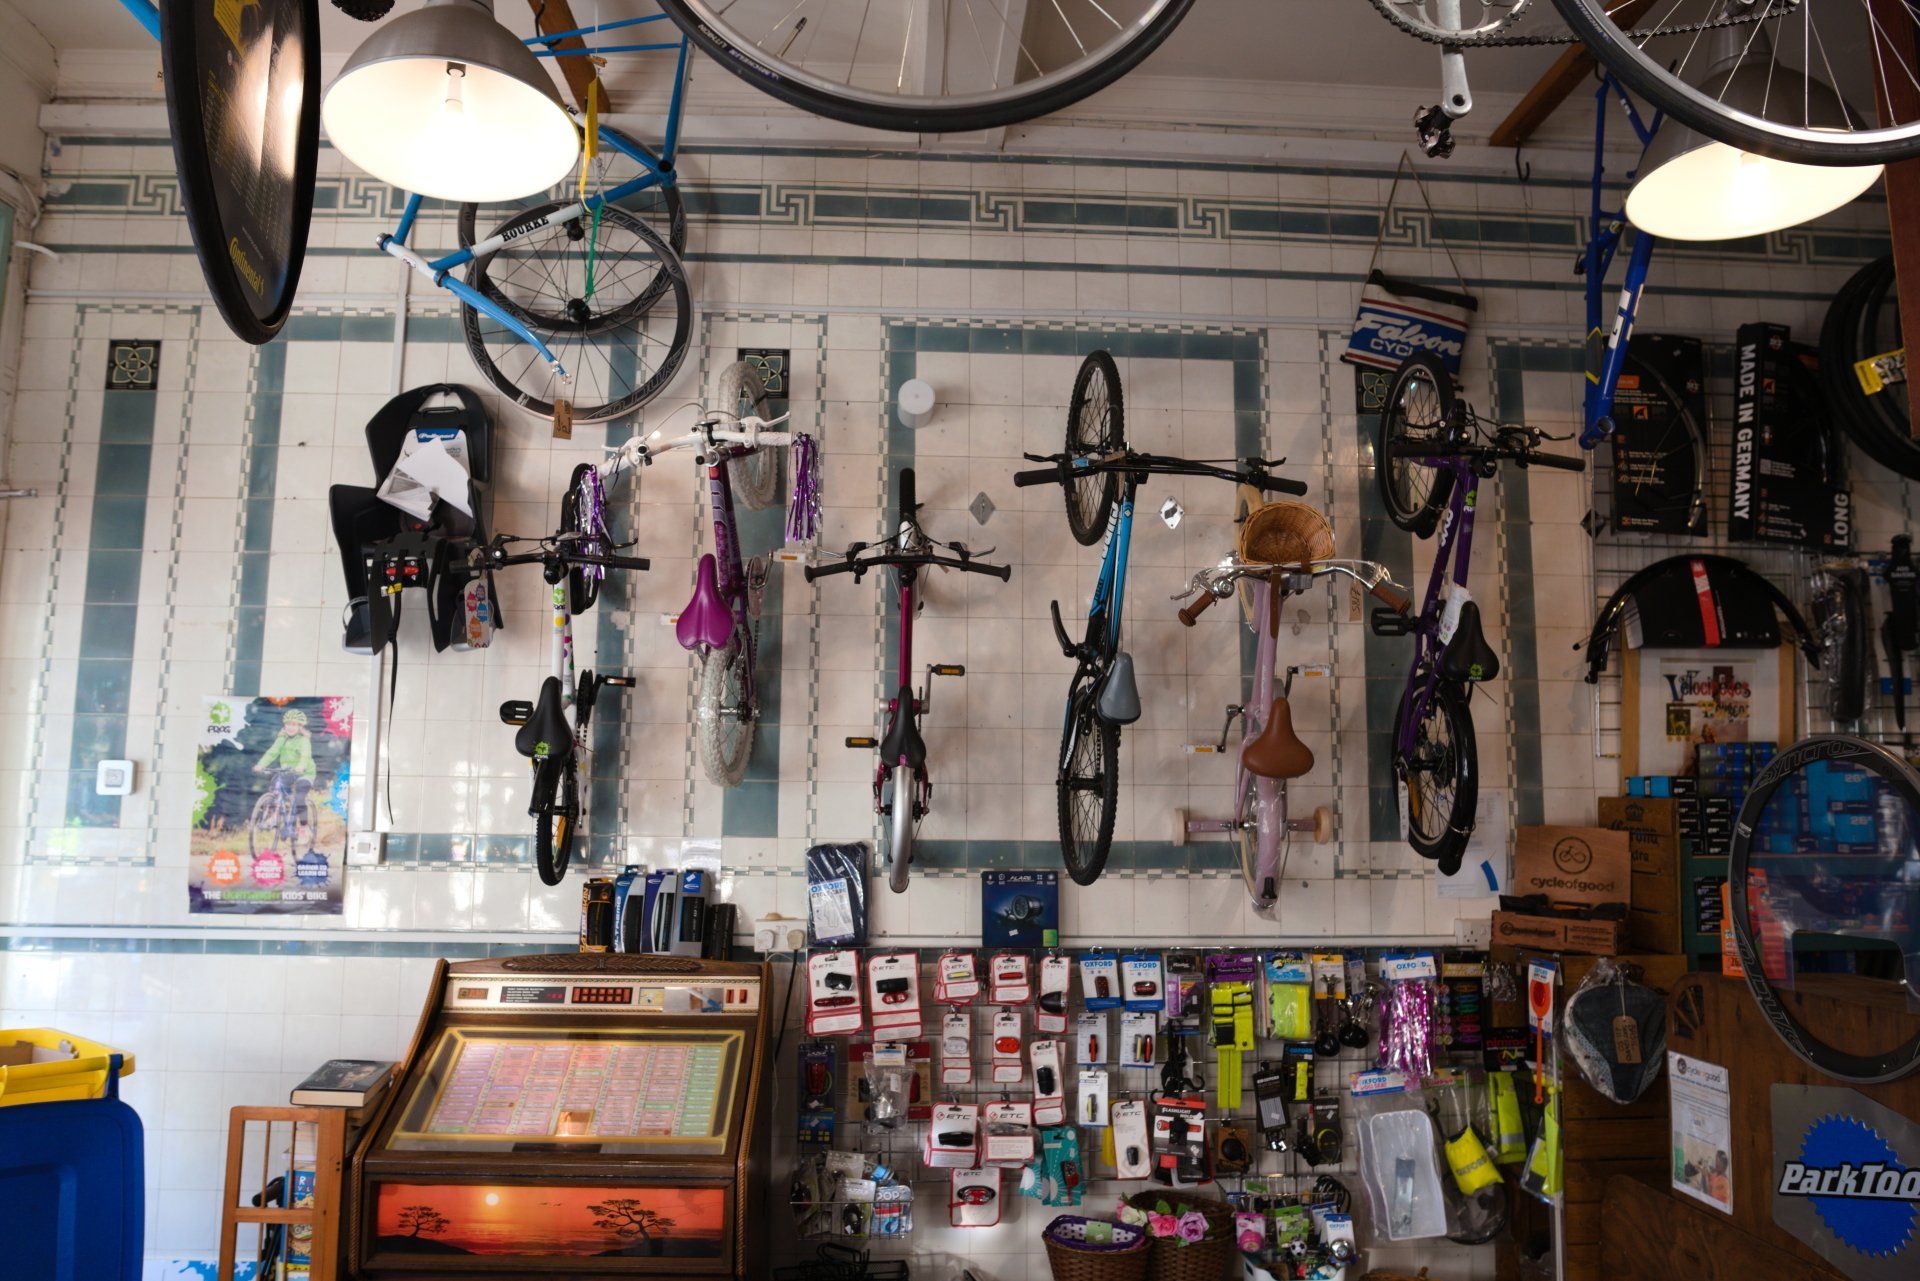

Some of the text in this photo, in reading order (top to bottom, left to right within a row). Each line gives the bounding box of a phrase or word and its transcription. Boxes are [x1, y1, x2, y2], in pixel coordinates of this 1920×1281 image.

[501, 217, 549, 242] ROURKE
[230, 237, 262, 293] Continental
[1353, 312, 1461, 356] Falcon
[1734, 343, 1756, 520] MADE IN GERMANY
[1833, 492, 1849, 546] LONG
[203, 891, 221, 900] THE
[282, 892, 305, 900] KIDS'
[306, 892, 327, 900] BIKE
[1396, 962, 1427, 970] OXFOD
[1779, 1162, 1920, 1199] ParkToo
